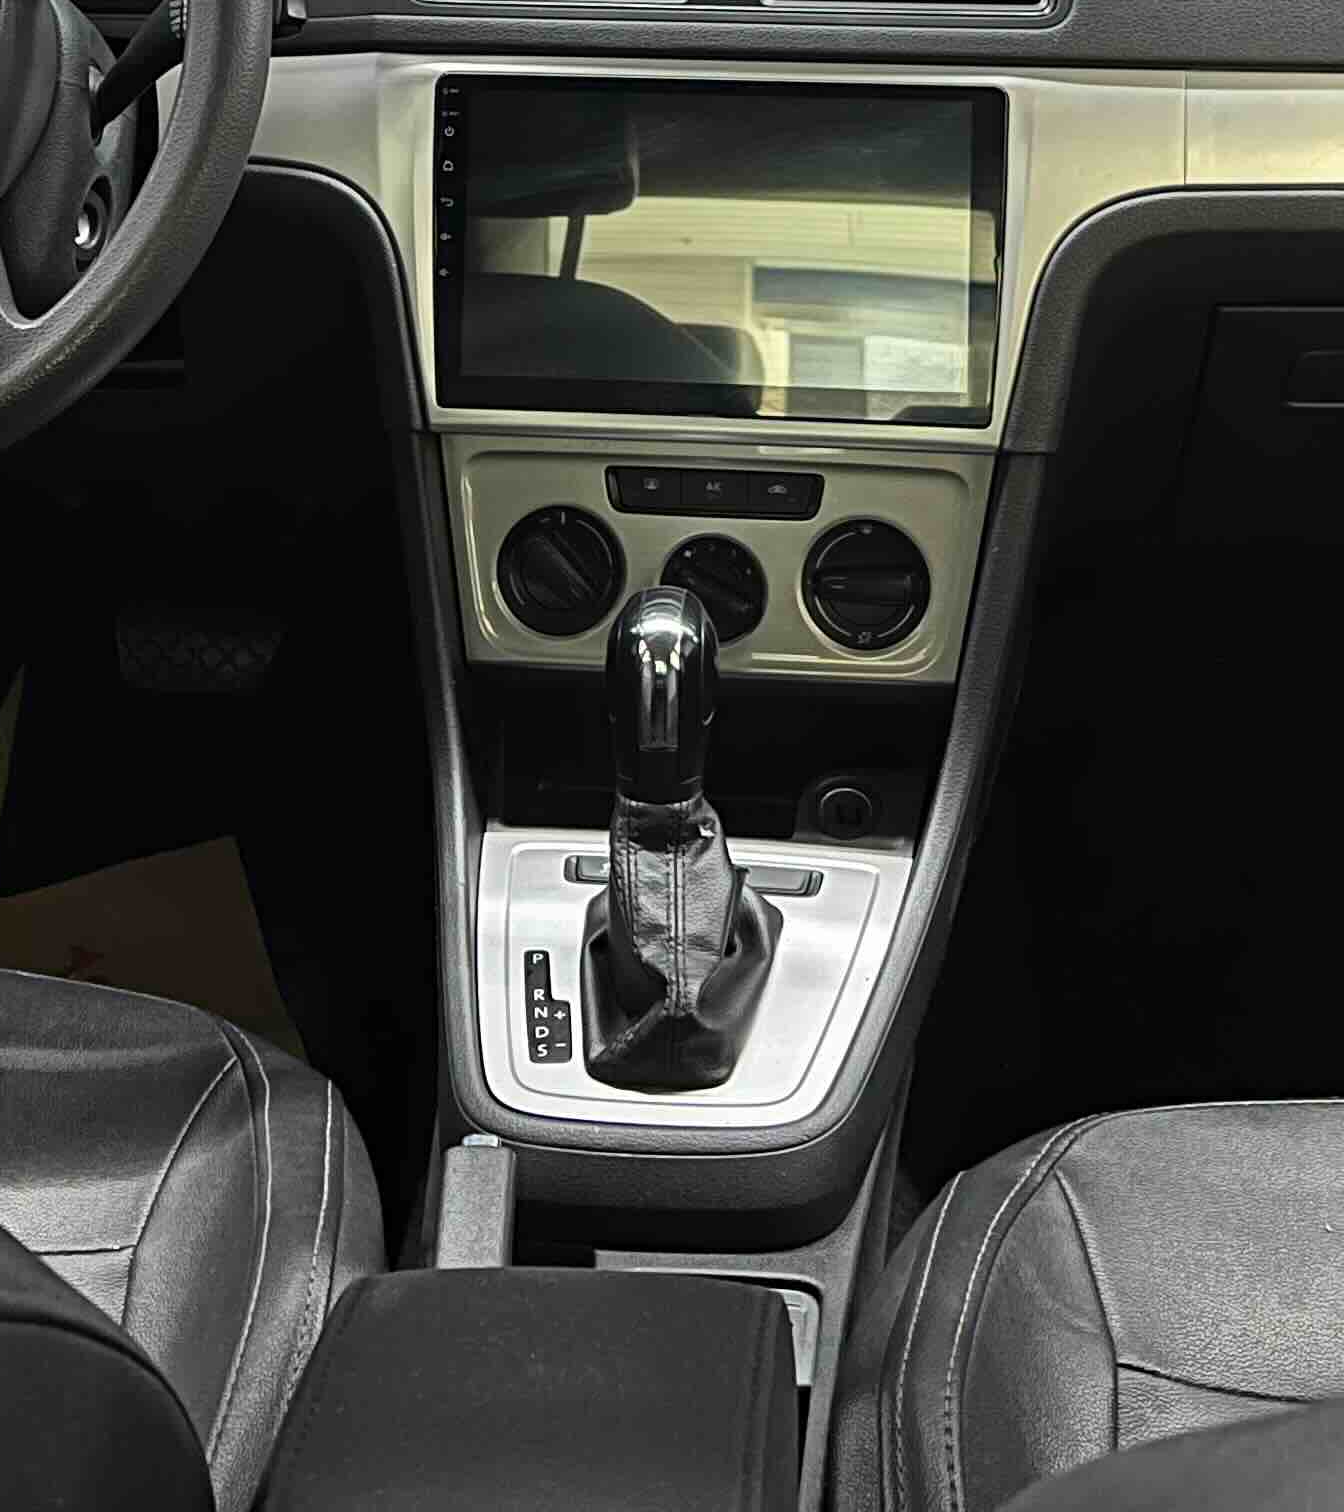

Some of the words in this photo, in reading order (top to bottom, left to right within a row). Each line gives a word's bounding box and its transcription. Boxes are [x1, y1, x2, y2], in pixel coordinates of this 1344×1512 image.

[532, 952, 544, 964] P
[533, 988, 545, 1001] R
[534, 1006, 548, 1019] N
[535, 1026, 549, 1039] D
[537, 1043, 548, 1057] S
